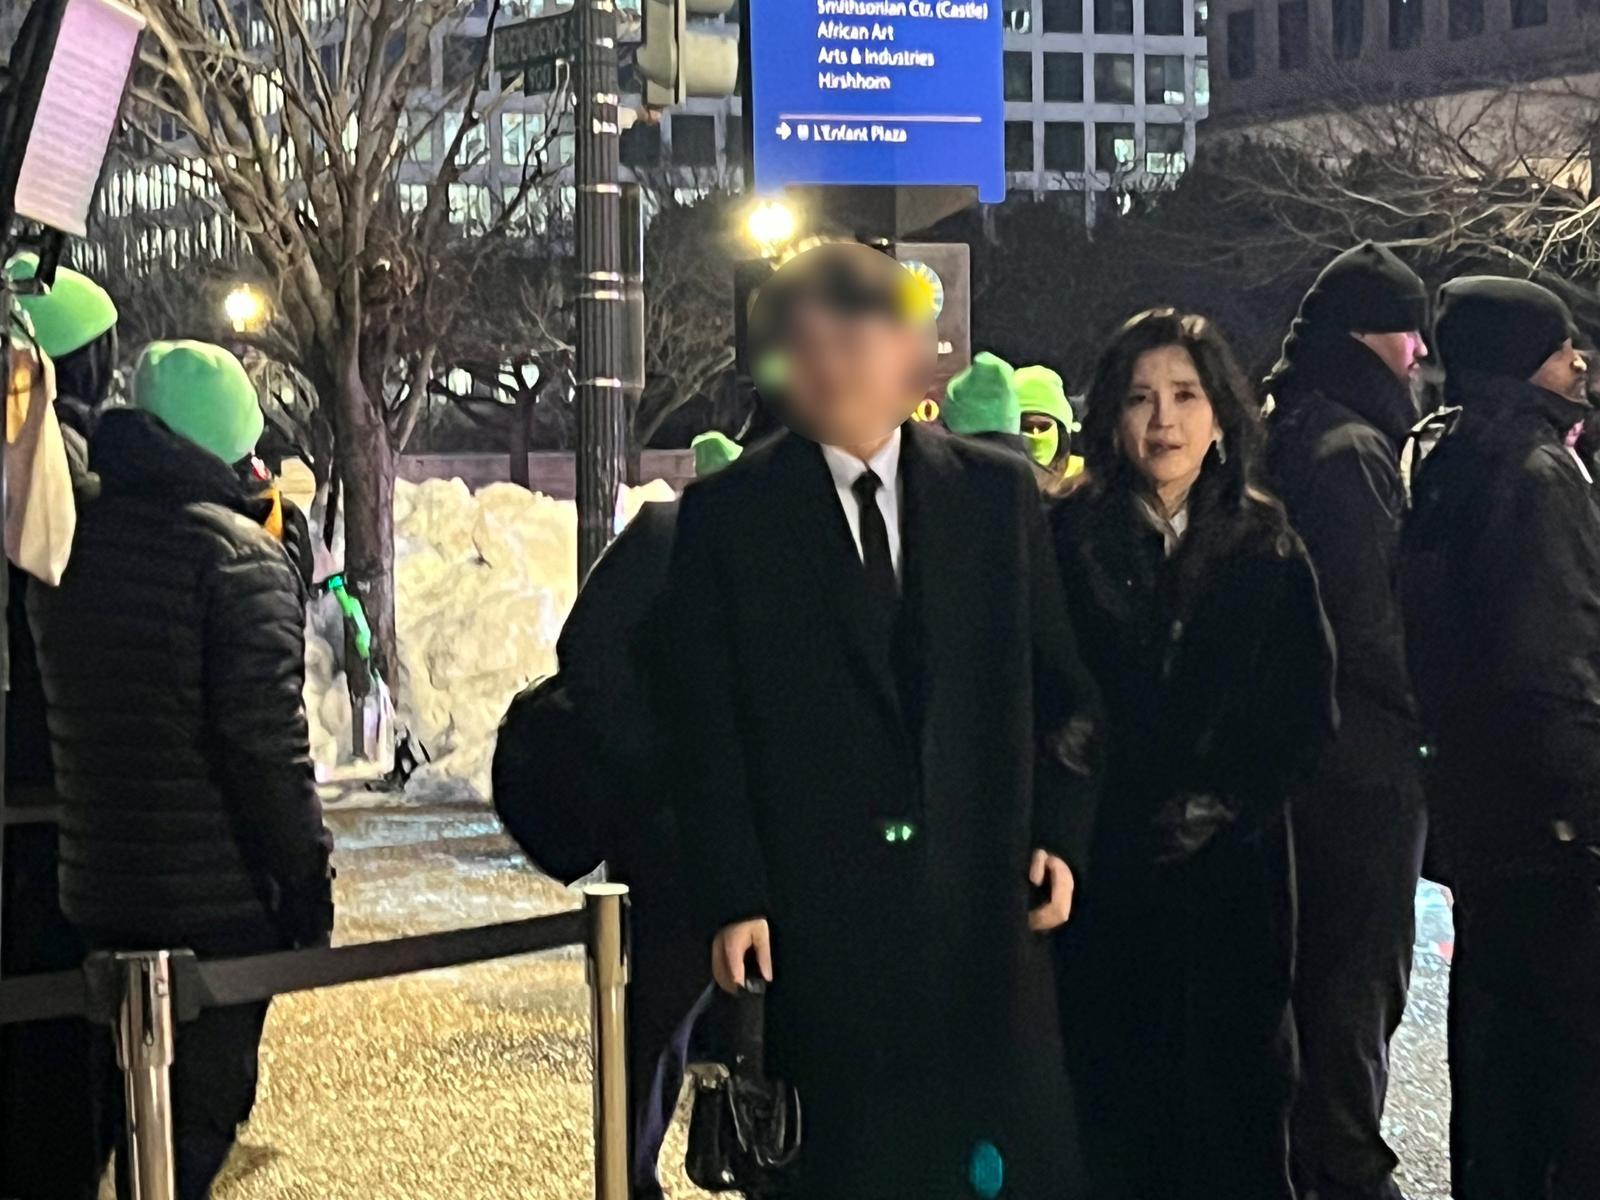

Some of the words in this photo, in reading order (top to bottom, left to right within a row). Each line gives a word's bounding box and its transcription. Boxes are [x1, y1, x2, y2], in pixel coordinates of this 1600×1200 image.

[817, 0, 906, 17] Smithsonian
[817, 21, 869, 41] African
[871, 23, 895, 41] Art
[818, 47, 848, 65] Arts
[850, 48, 862, 65] &
[865, 48, 935, 67] Industries
[818, 72, 891, 89] Hirshhorn
[871, 125, 907, 143] Plaza
